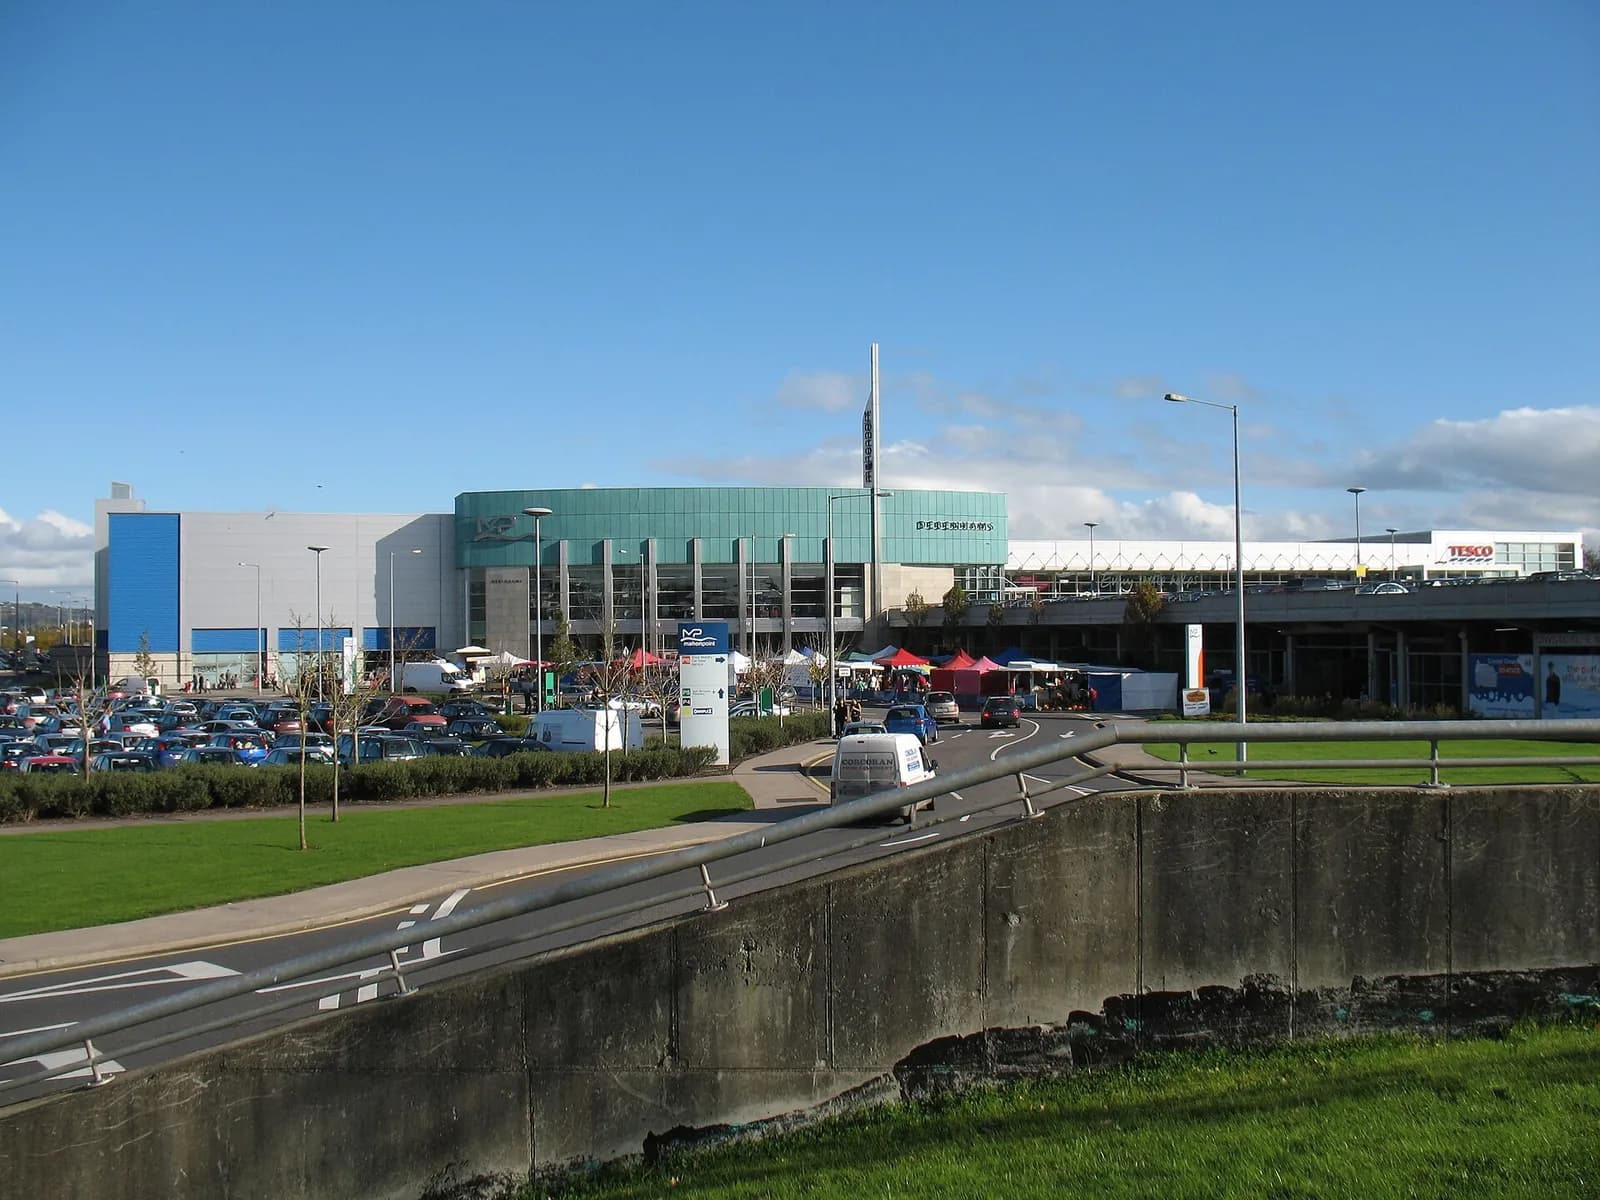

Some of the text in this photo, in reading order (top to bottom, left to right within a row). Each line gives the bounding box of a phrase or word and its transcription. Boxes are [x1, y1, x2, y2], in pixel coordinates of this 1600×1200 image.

[916, 521, 994, 532] DEBENHAMS
[1448, 546, 1493, 557] TESCO
[841, 758, 895, 766] CORCORAN
